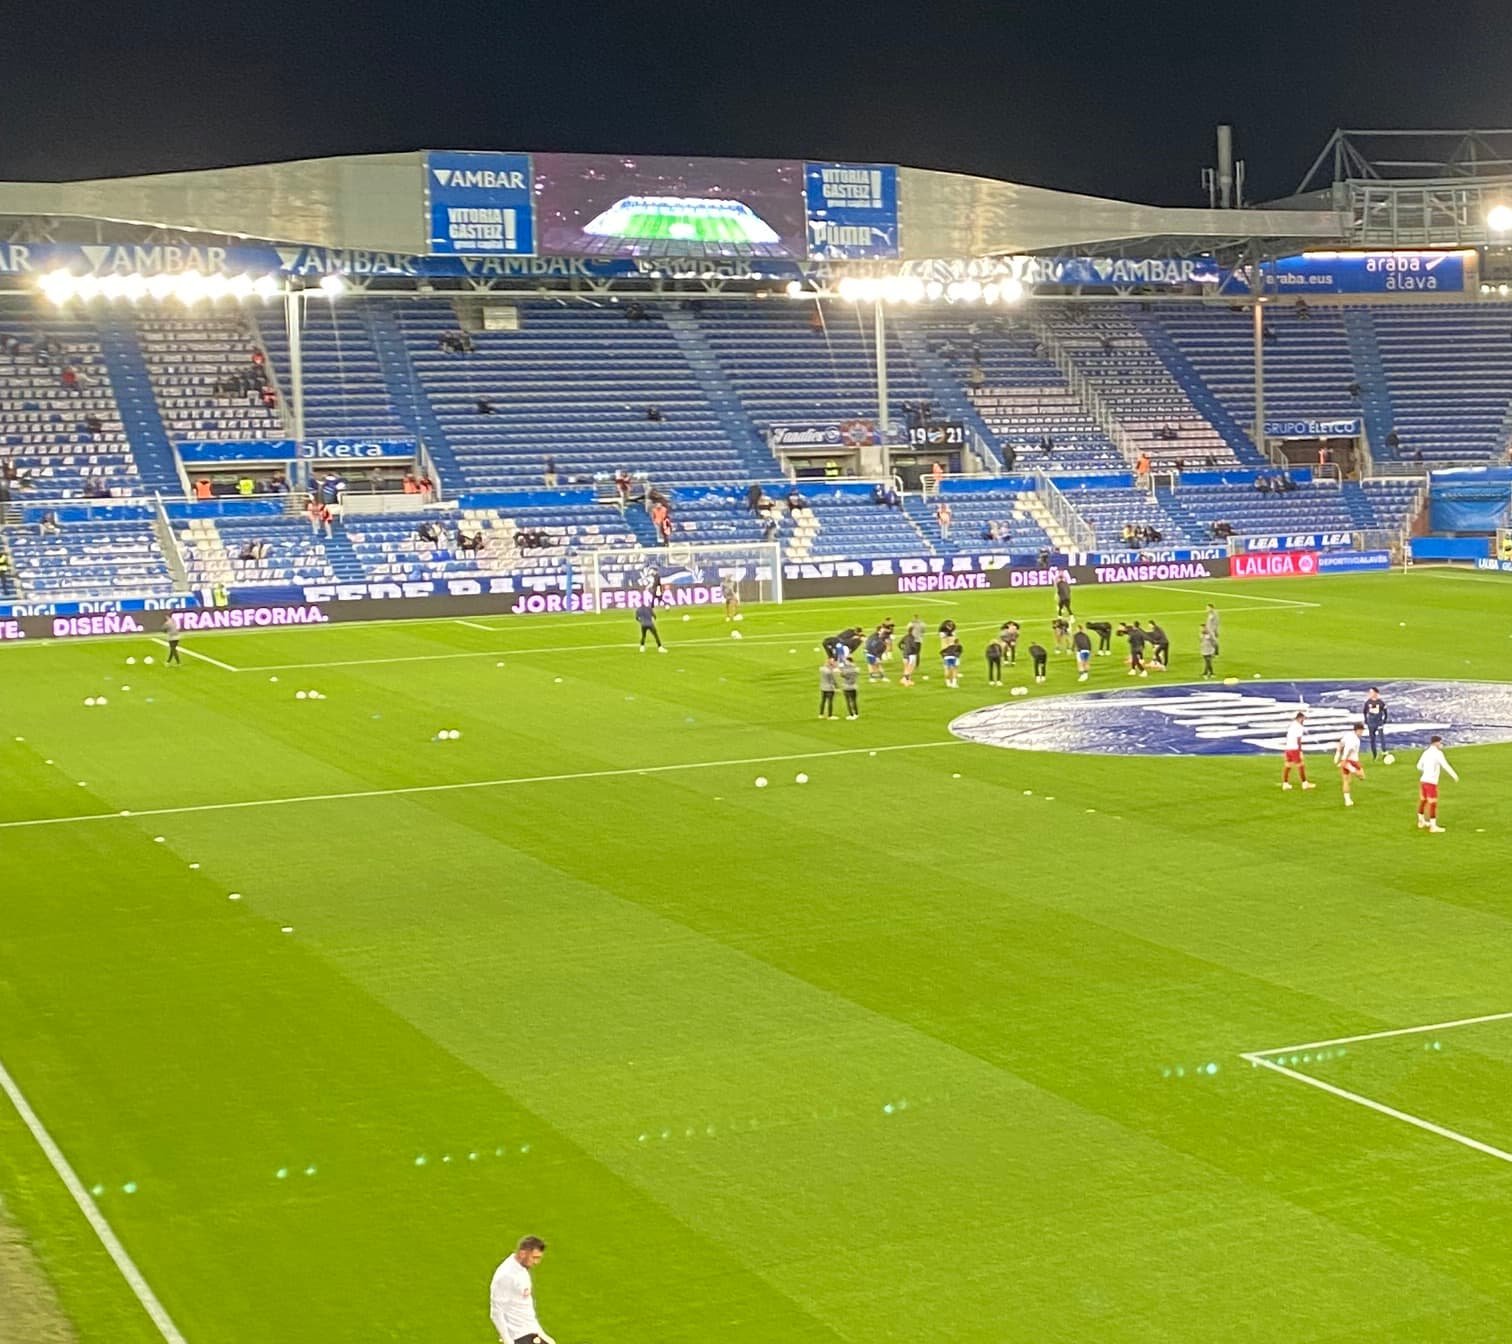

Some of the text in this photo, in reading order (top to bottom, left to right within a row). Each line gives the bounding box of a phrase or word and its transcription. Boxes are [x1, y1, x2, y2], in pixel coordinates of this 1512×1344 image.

[450, 170, 527, 189] AMBAR
[109, 245, 229, 274] AMBAR
[303, 248, 419, 275] AMBAR
[1366, 256, 1420, 272] araba
[1113, 259, 1196, 282] AMBAR
[1385, 272, 1437, 290] álava
[909, 427, 963, 445] 19 21
[1248, 533, 1351, 550] LEA LEA LEA
[1235, 557, 1294, 575] LALIGA
[898, 570, 991, 593] INSPÍRATE.
[1094, 562, 1211, 583] TRANSFORMA.
[511, 591, 594, 614] JORGE
[52, 613, 144, 637] DISEÑA.
[171, 605, 329, 631] TRANSFORMA.
